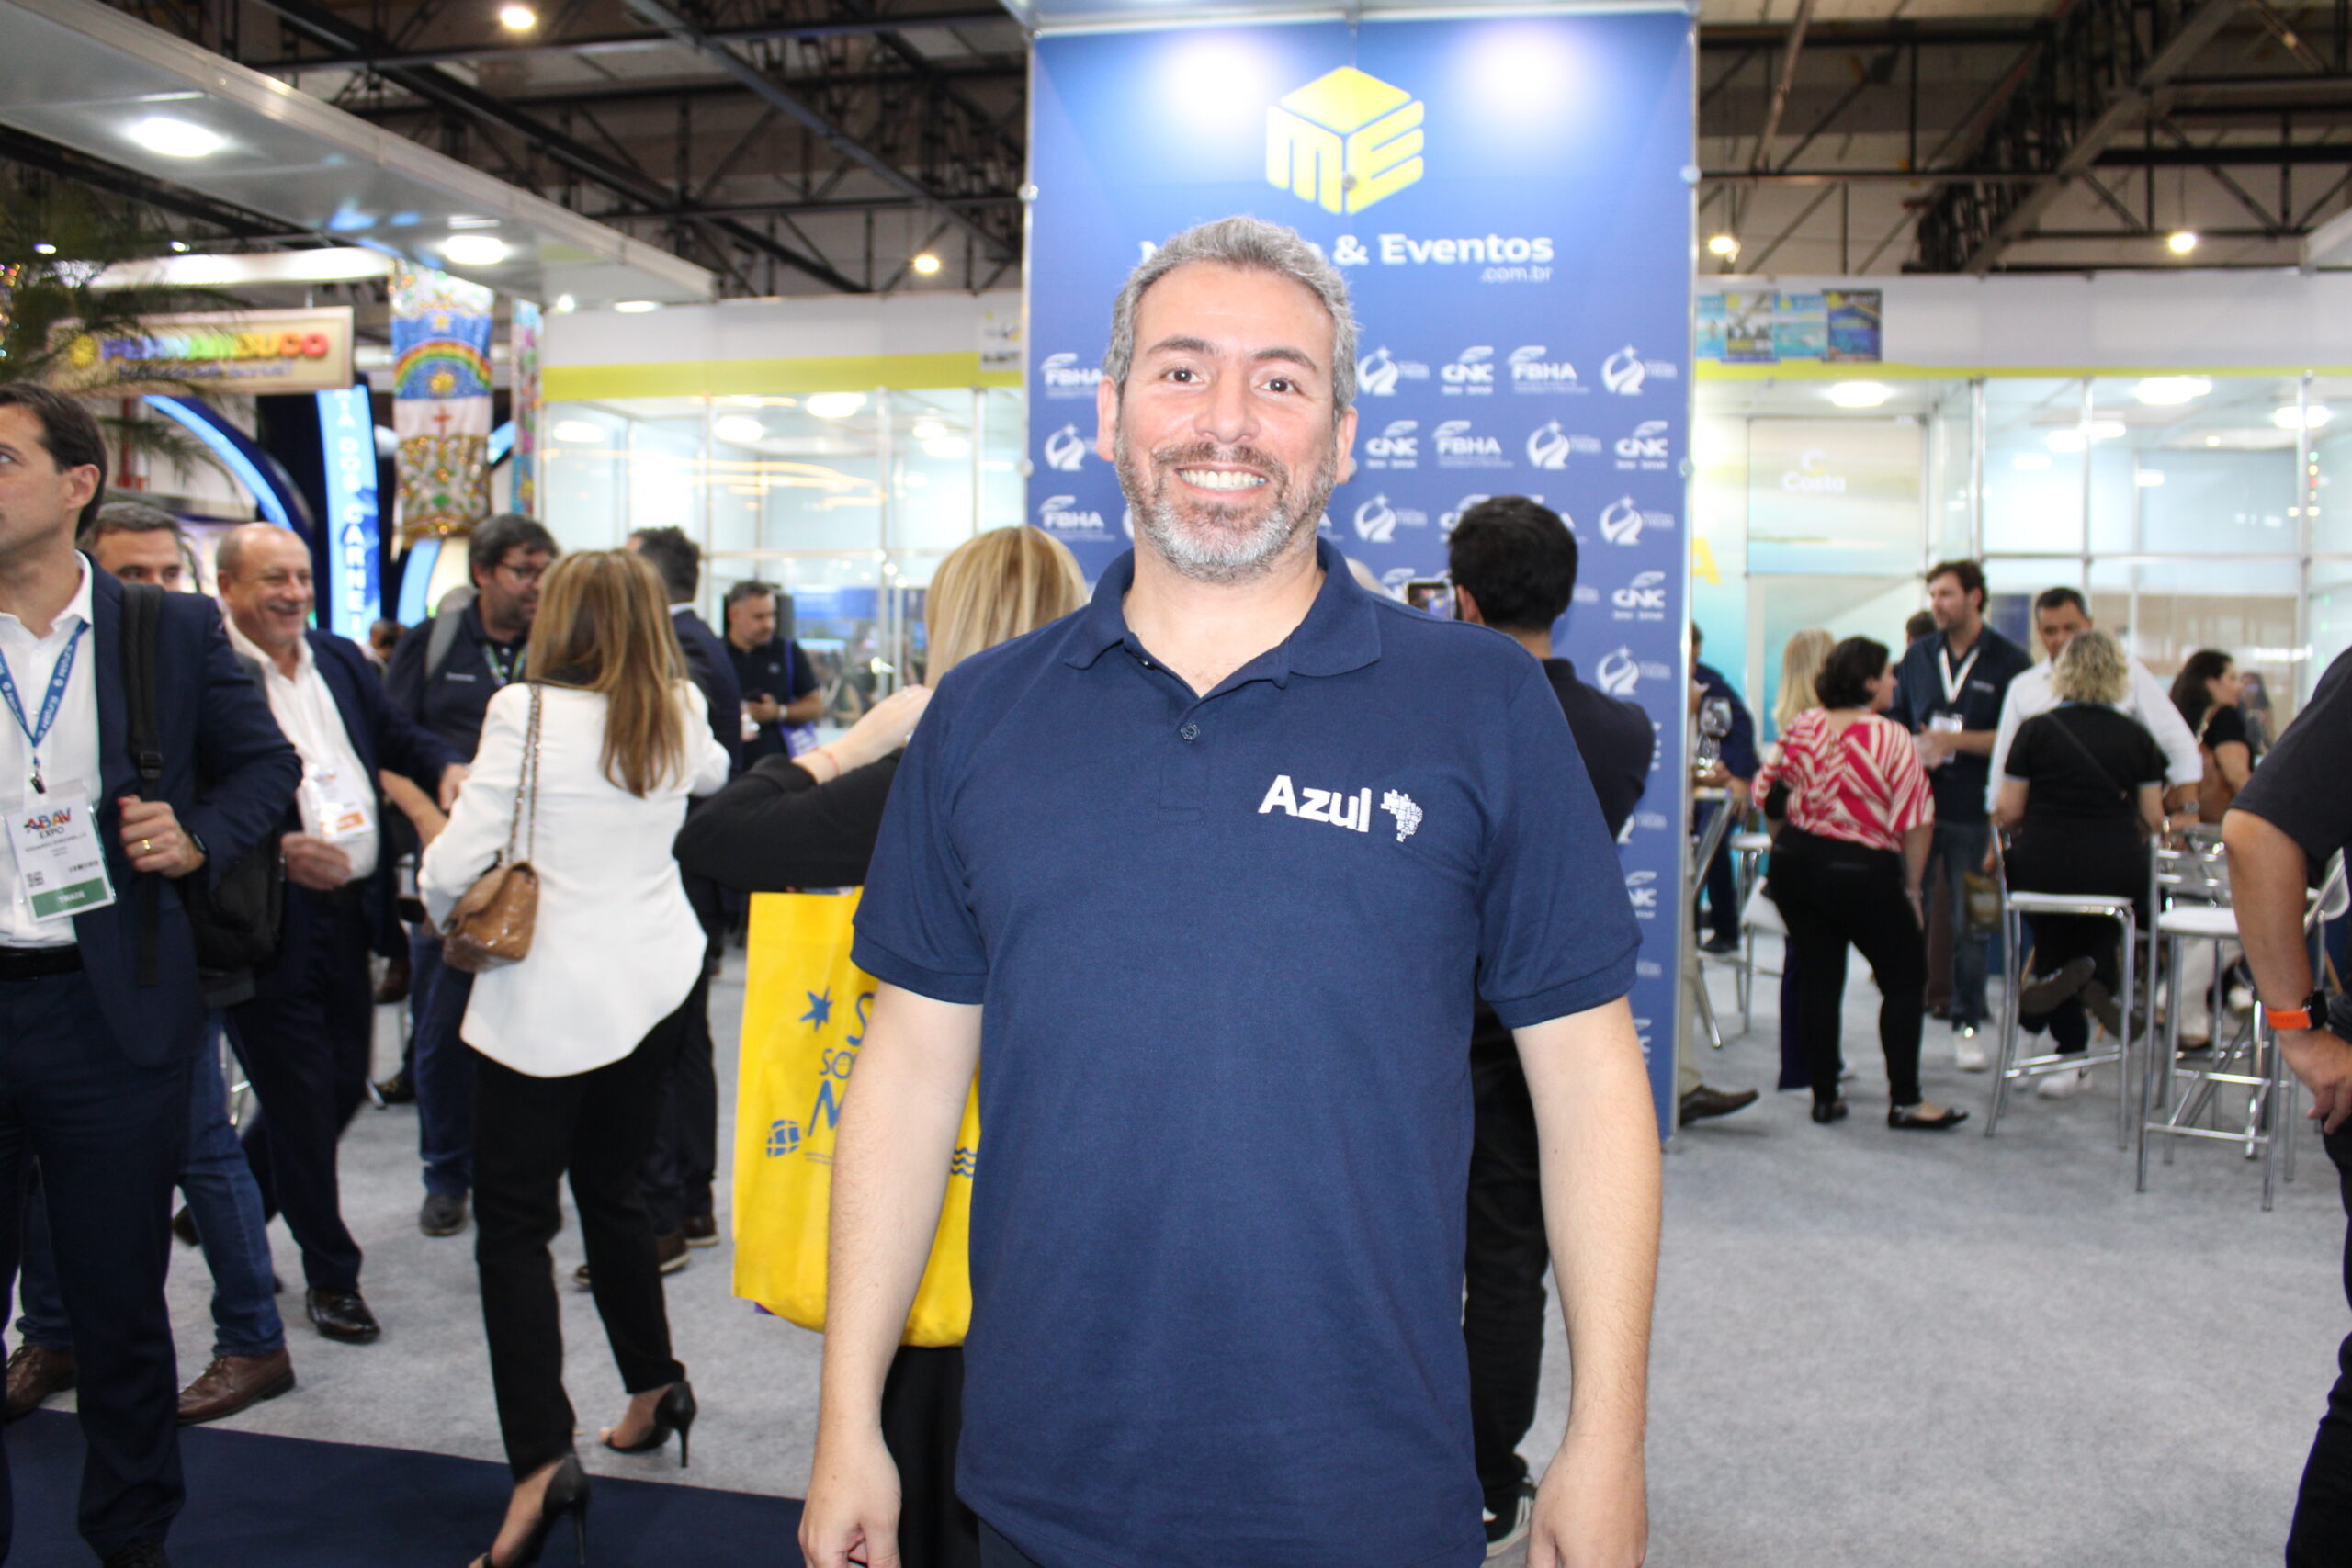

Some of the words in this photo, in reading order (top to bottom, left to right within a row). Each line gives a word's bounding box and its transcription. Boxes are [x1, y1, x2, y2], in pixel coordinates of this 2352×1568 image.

[1333, 235, 1369, 265] &
[1379, 233, 1554, 264] Eventos
[1481, 265, 1552, 283] .com.br
[1441, 362, 1495, 385] CNC
[1511, 362, 1578, 381] FBHA
[1366, 436, 1419, 458] CNC
[1436, 436, 1503, 456] FBHA
[1614, 437, 1669, 458] CNC
[1043, 511, 1105, 529] FBHA
[1612, 588, 1667, 609] CNC
[1257, 774, 1373, 833] Azul
